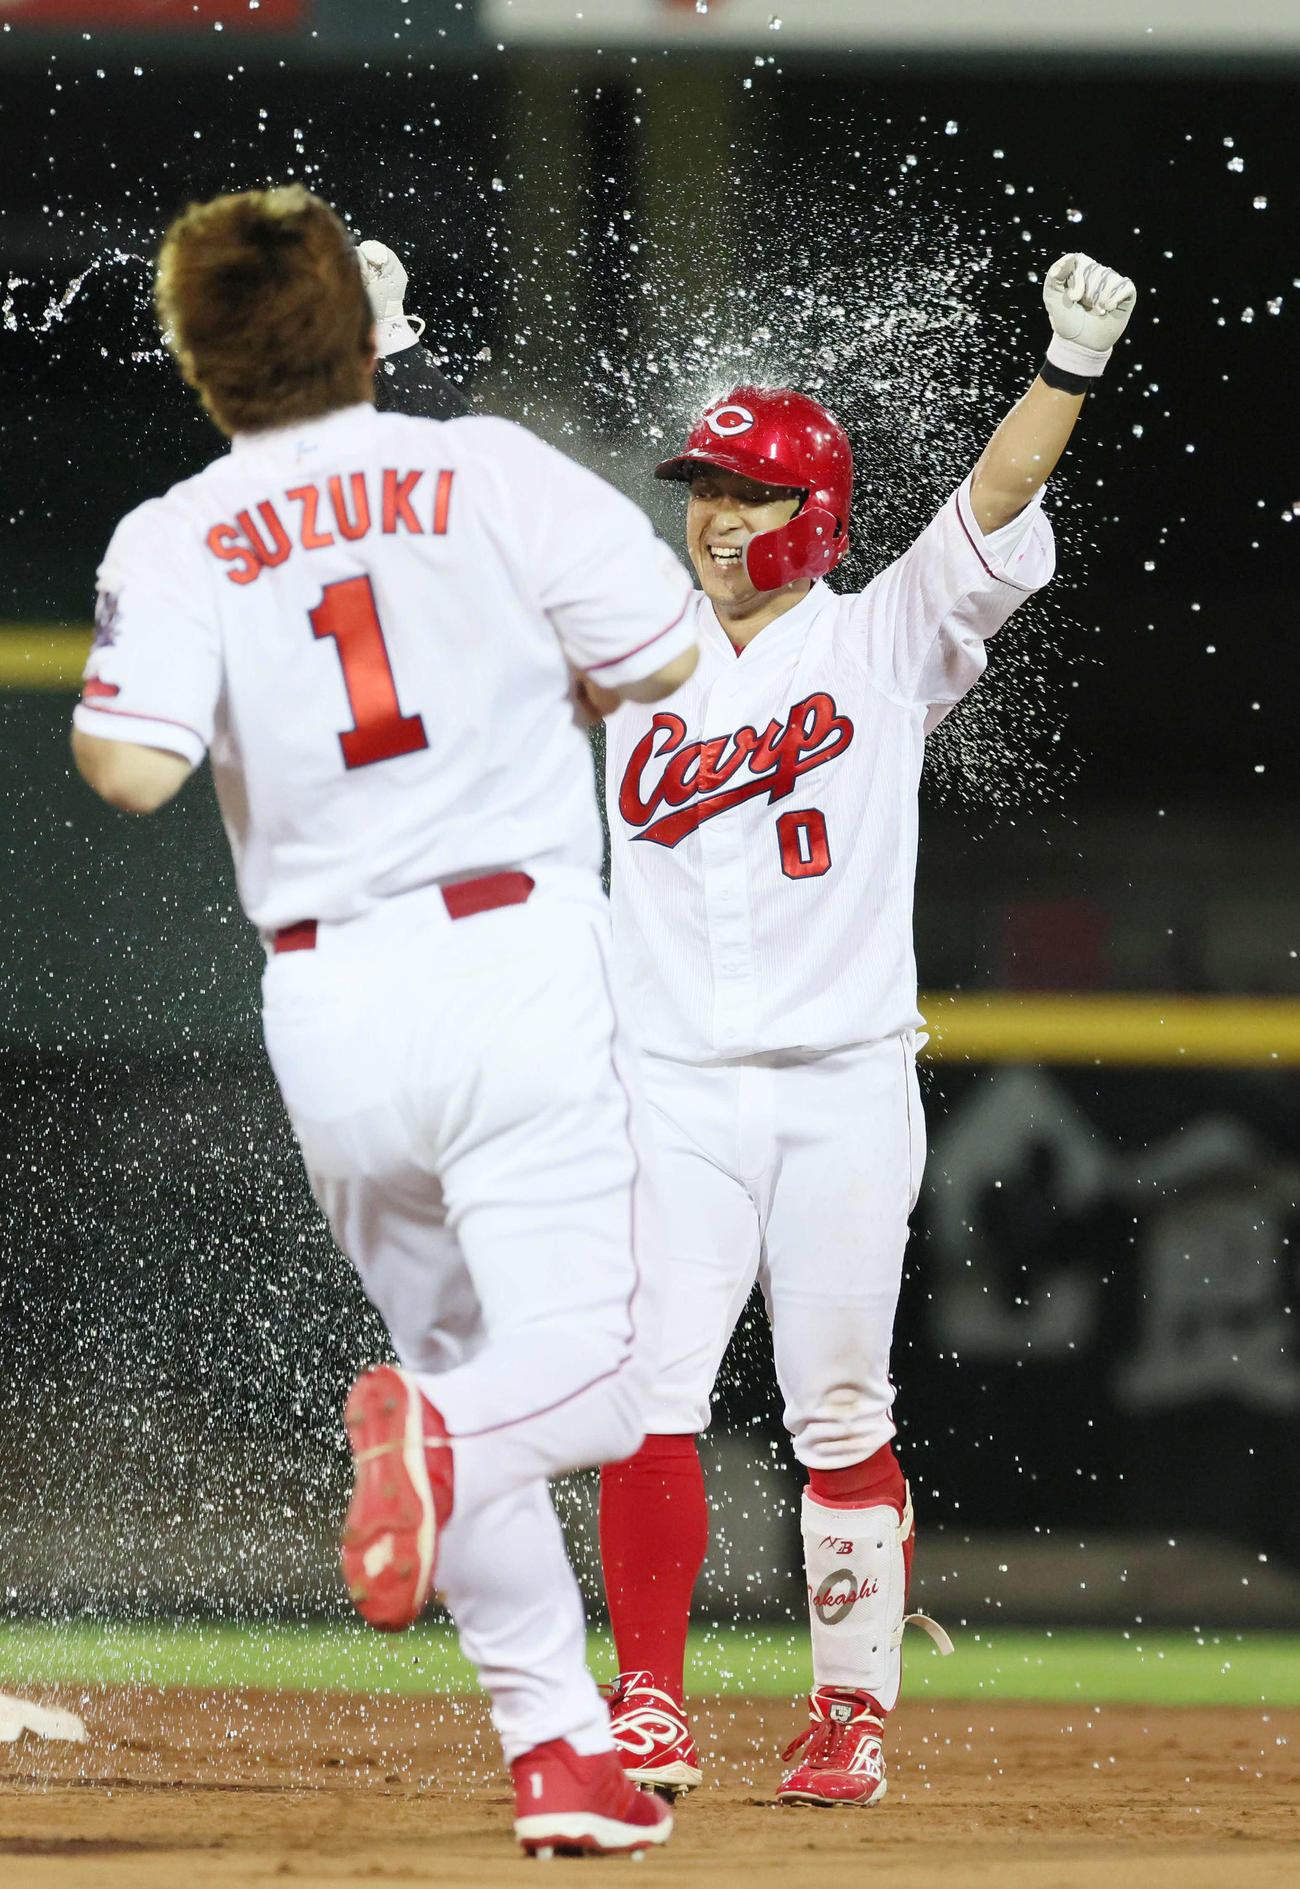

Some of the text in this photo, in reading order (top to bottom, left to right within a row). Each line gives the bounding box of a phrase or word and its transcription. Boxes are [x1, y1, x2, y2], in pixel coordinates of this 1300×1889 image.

[206, 469, 454, 585] SUZUKI
[308, 573, 429, 770] 1
[619, 692, 854, 848] Carp
[776, 808, 832, 880] 0
